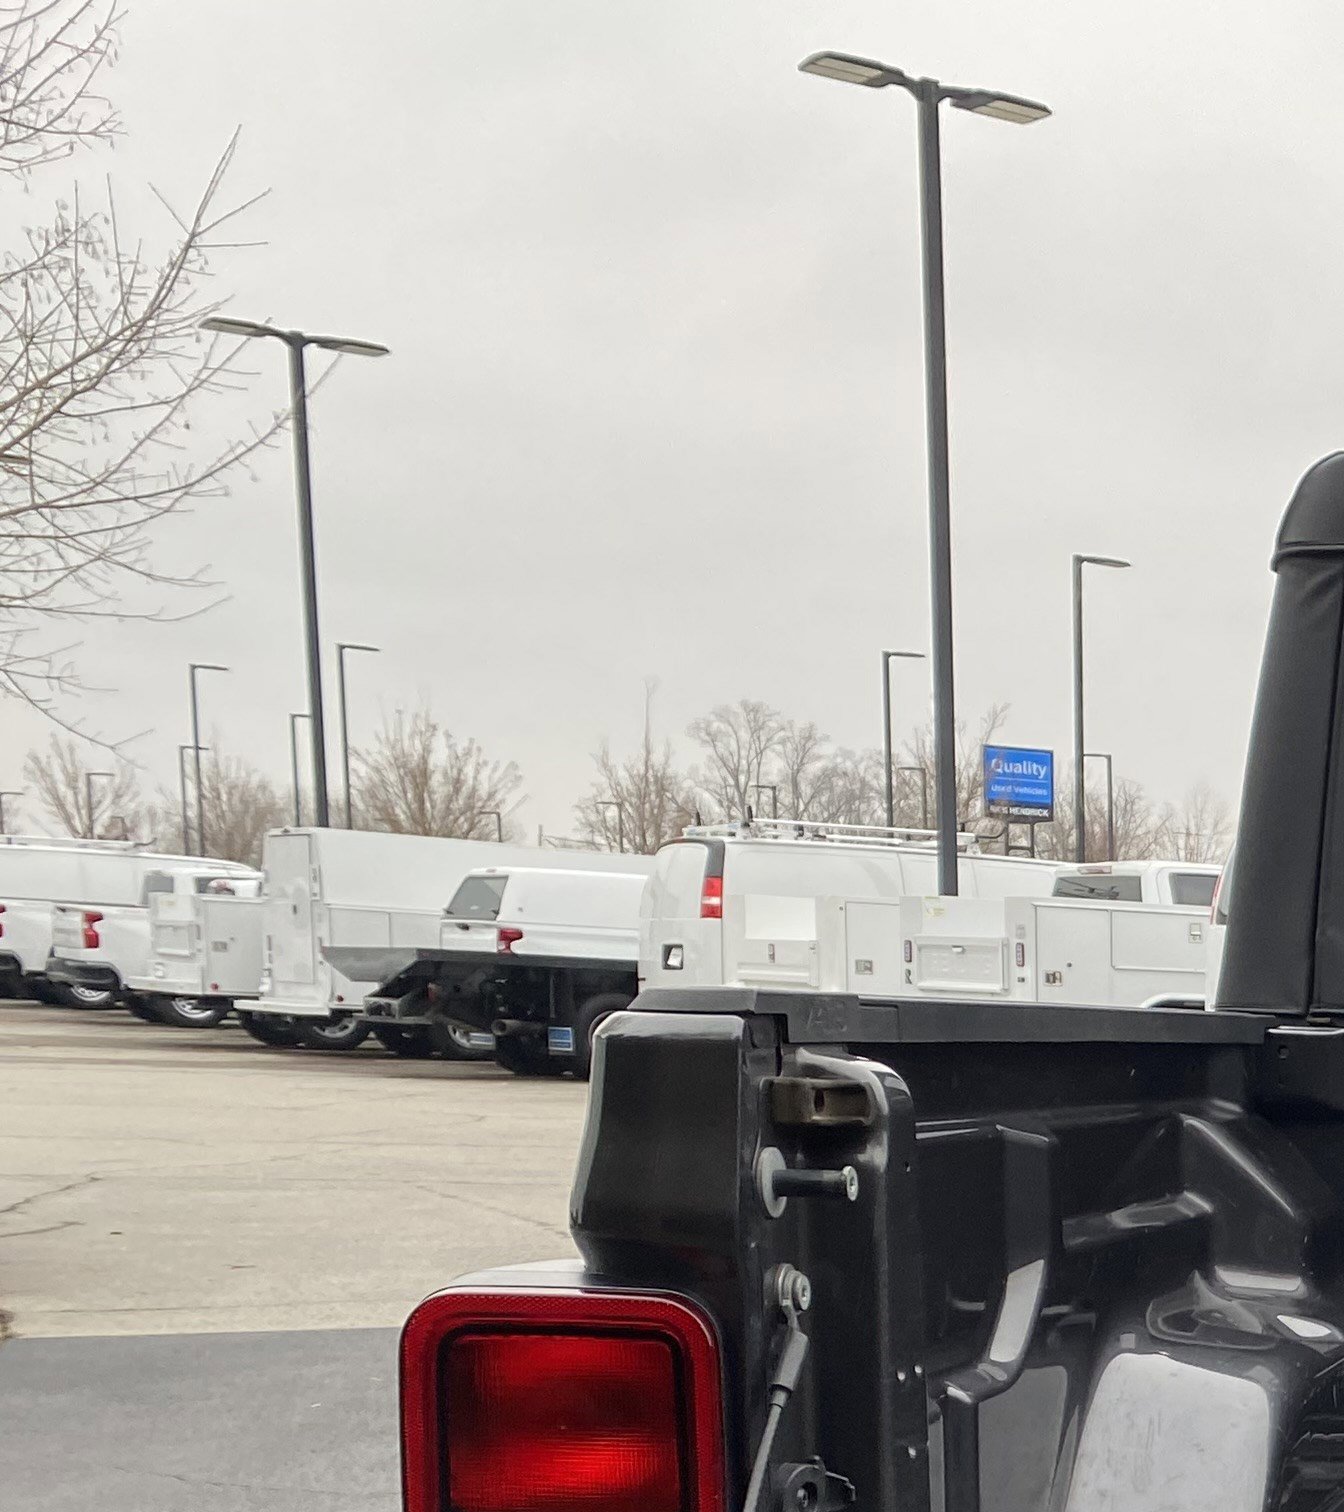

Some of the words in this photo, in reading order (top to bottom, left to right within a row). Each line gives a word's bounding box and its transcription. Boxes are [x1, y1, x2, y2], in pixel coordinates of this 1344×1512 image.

[990, 758, 1048, 779] Quality
[991, 784, 1012, 793] Used
[1014, 785, 1048, 796] Vehicles
